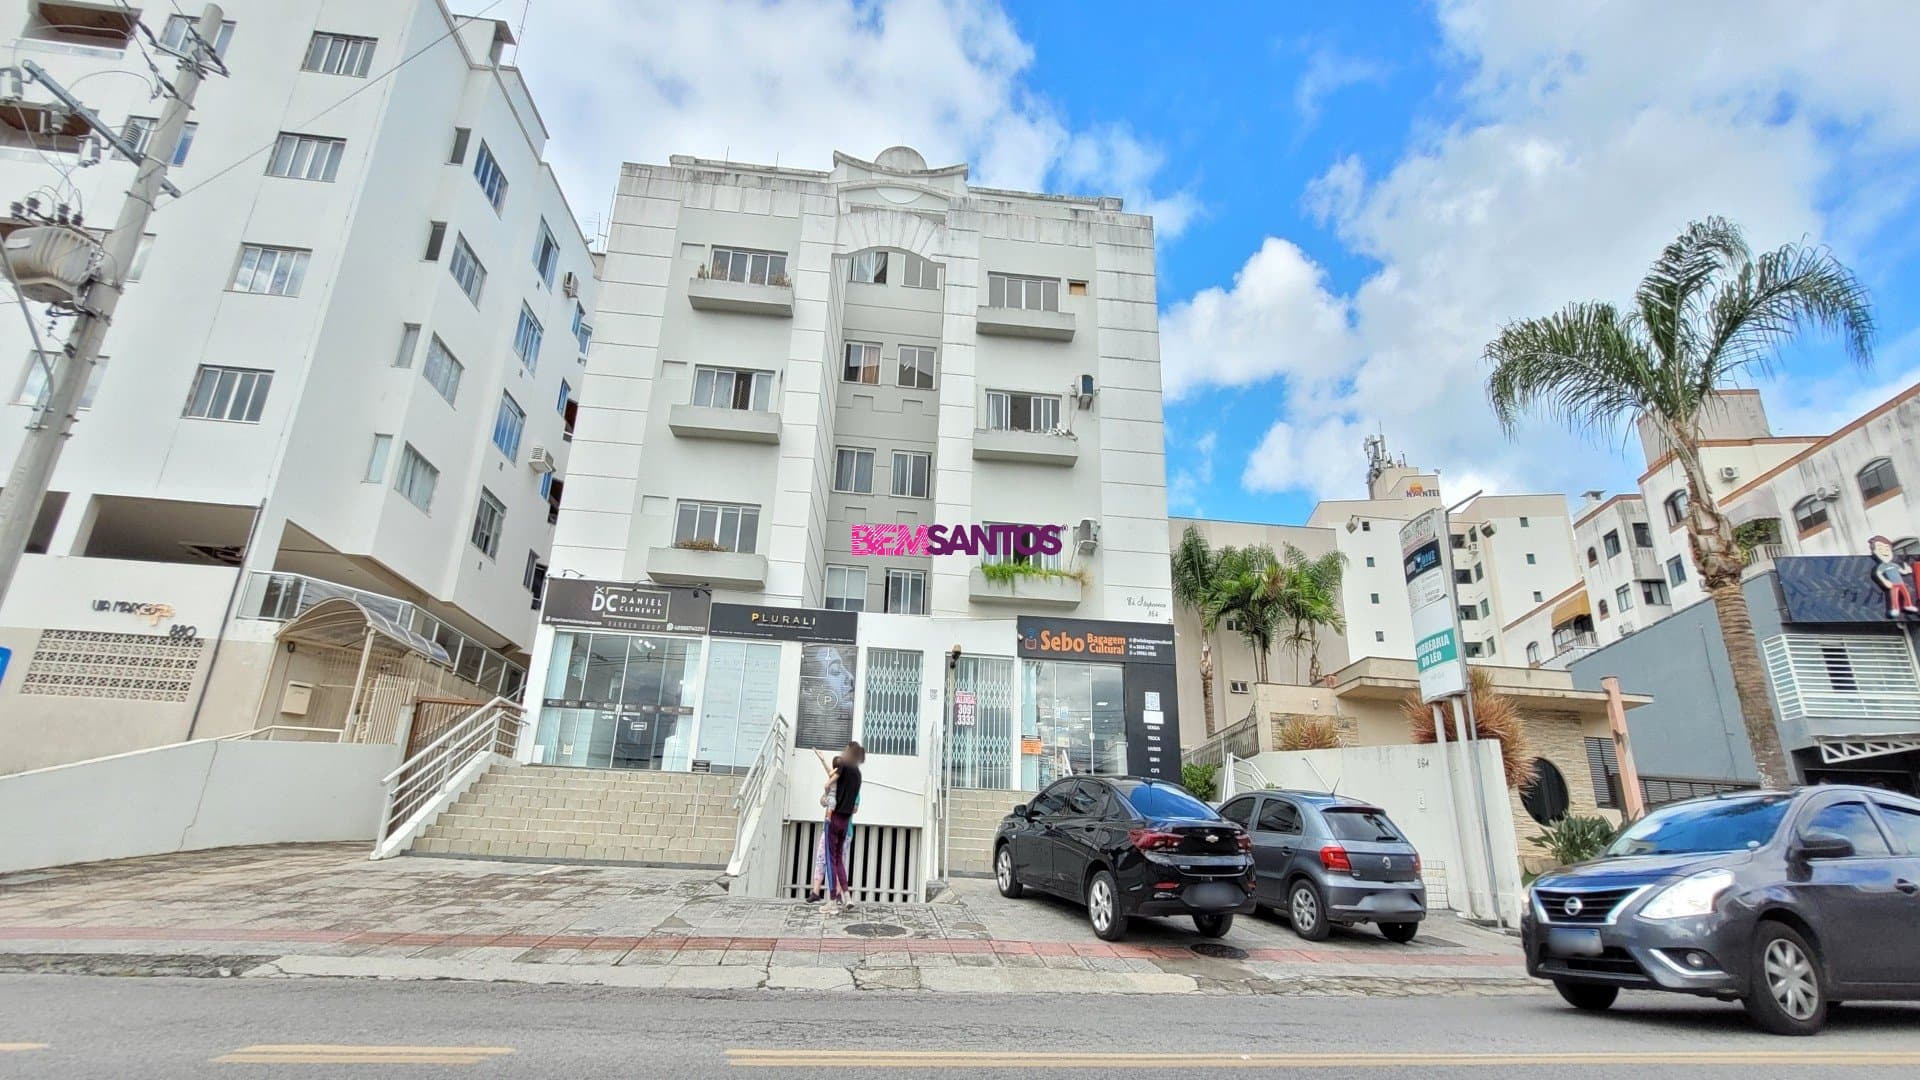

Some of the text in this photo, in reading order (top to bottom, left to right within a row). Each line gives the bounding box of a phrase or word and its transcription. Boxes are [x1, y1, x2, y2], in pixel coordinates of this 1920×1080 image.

[591, 593, 619, 612] DC
[620, 595, 662, 607] DANIEL
[619, 605, 662, 615] CLEMENTE
[751, 612, 817, 626] PLURALI
[169, 624, 197, 638] 880
[1040, 630, 1085, 652] Sebo
[1086, 633, 1126, 647] Bagagem
[1088, 643, 1125, 656] Cultural
[957, 704, 975, 715] 3091
